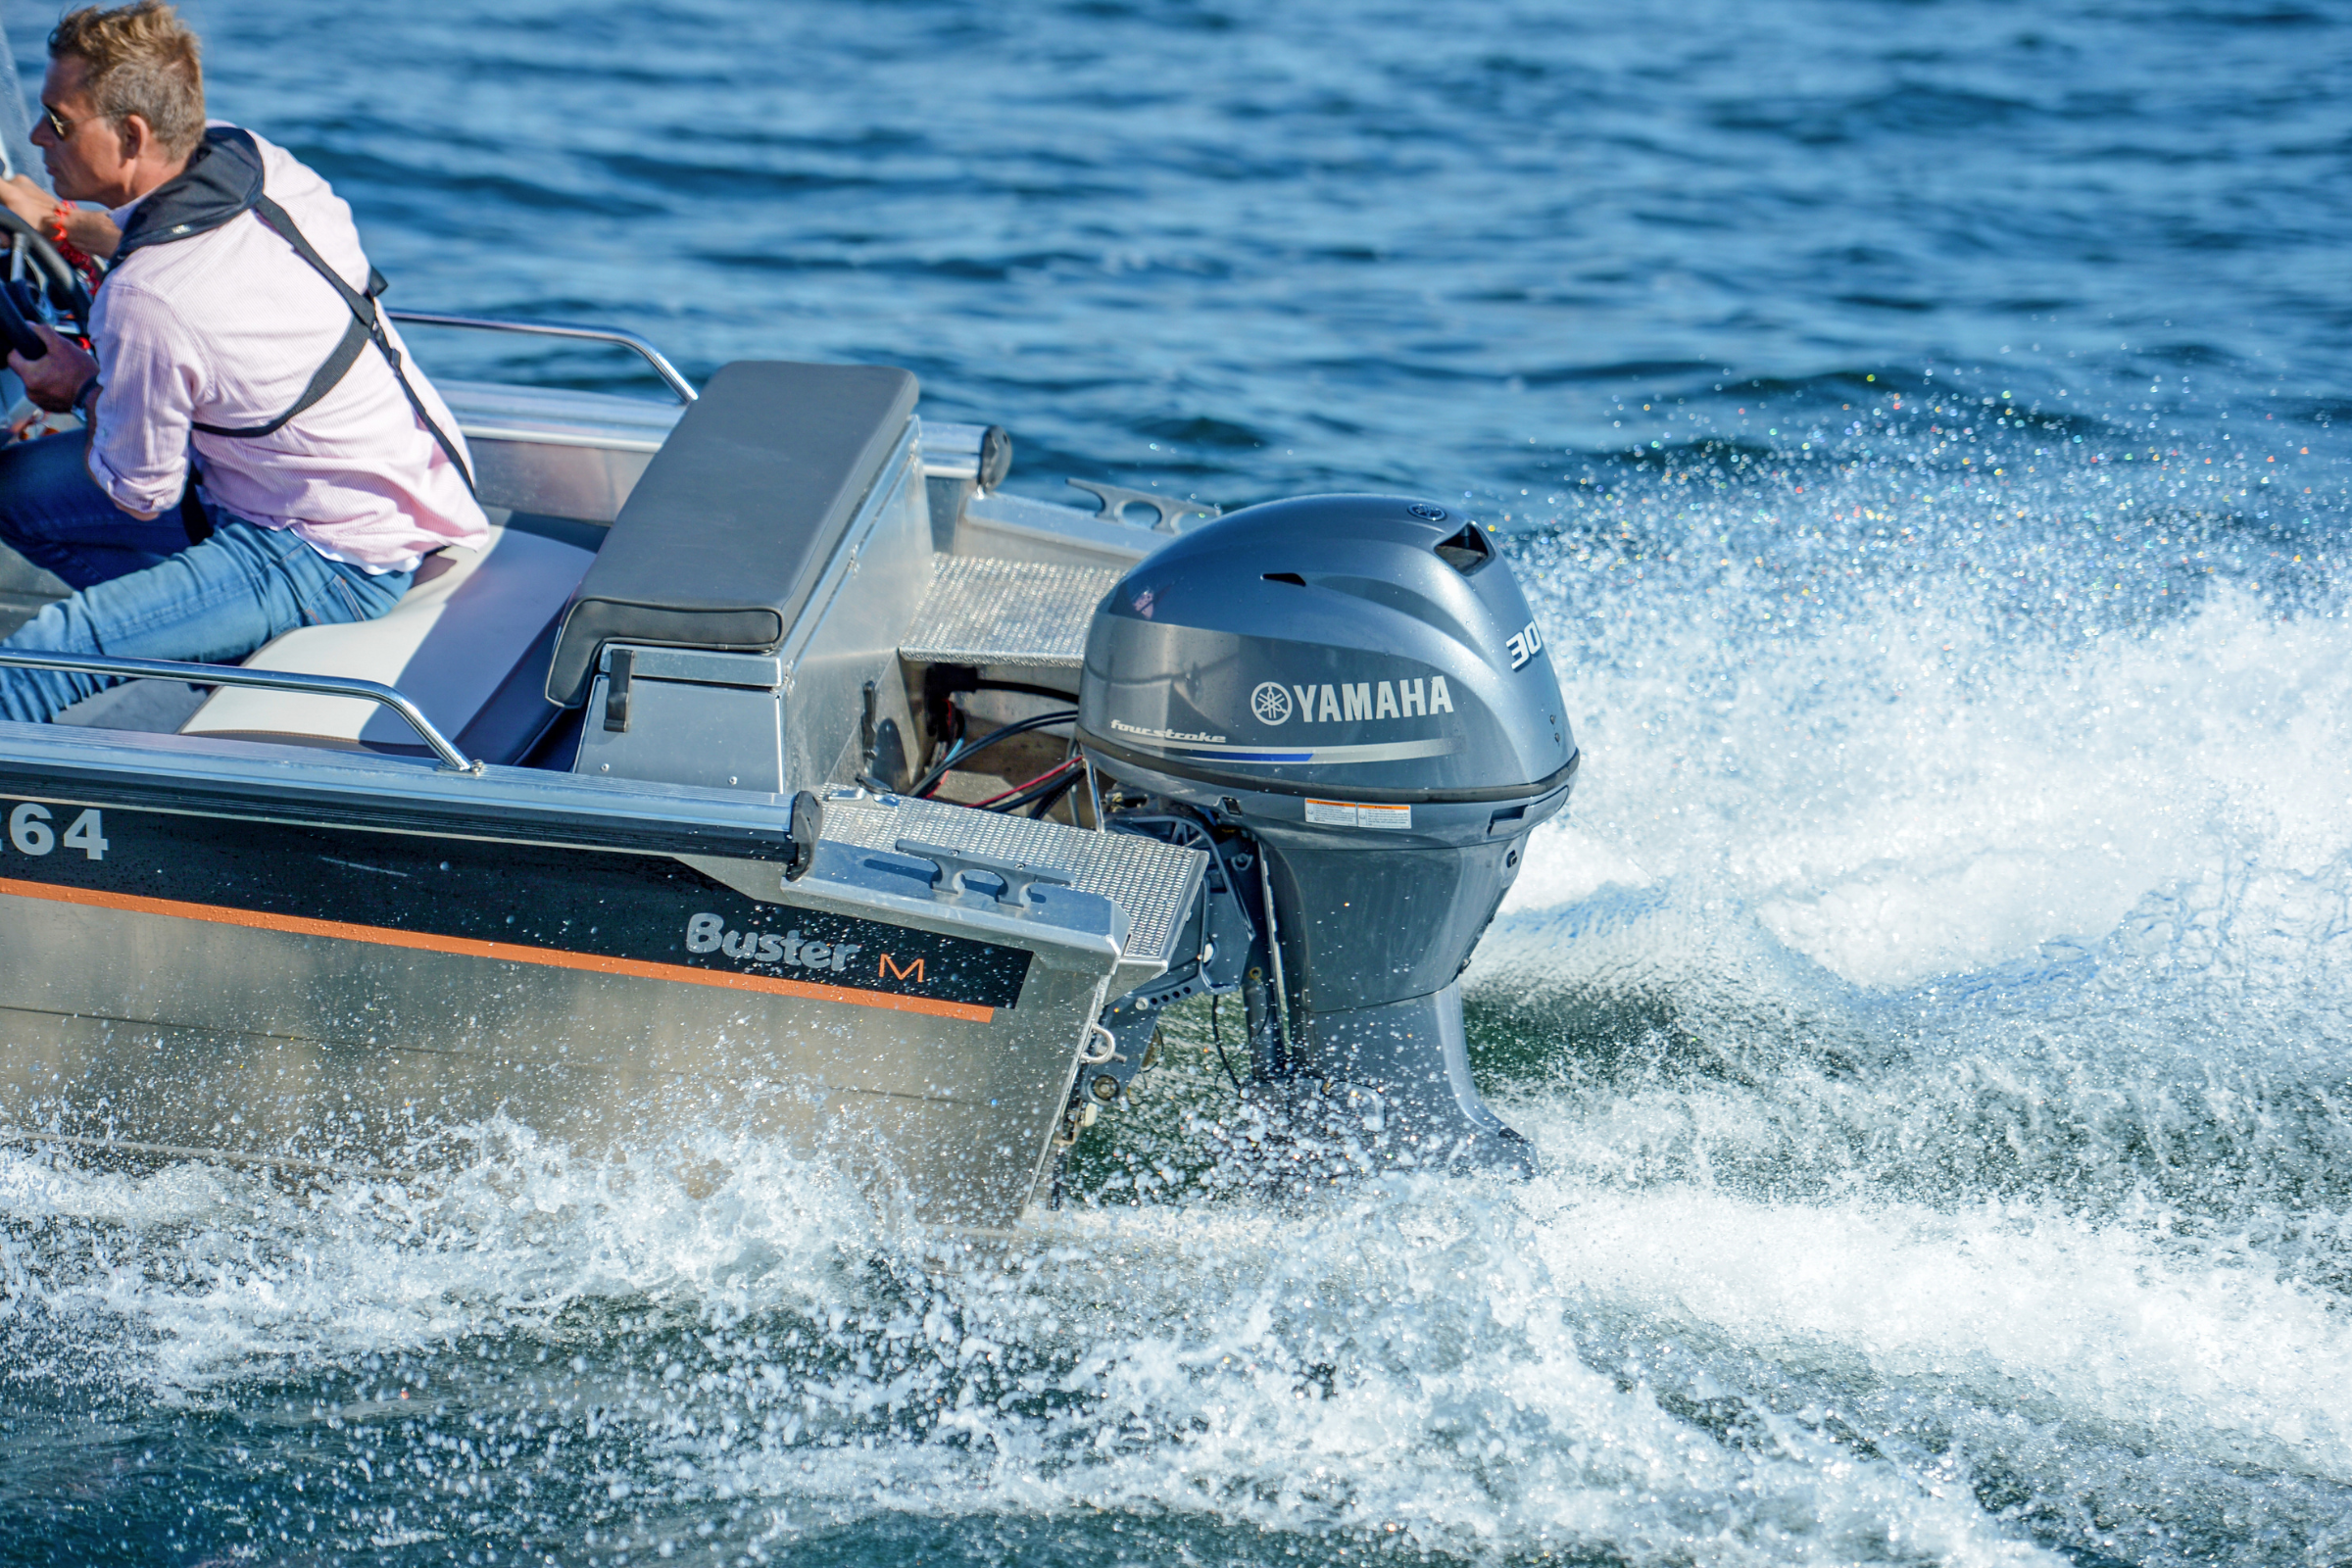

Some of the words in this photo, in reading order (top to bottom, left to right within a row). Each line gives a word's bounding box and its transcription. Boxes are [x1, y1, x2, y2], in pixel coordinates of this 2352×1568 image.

[1505, 620, 1543, 670] 30
[1293, 675, 1454, 723] YAMAHA
[0, 802, 109, 860] 64
[687, 912, 860, 972] Buster
[878, 954, 924, 983] M
